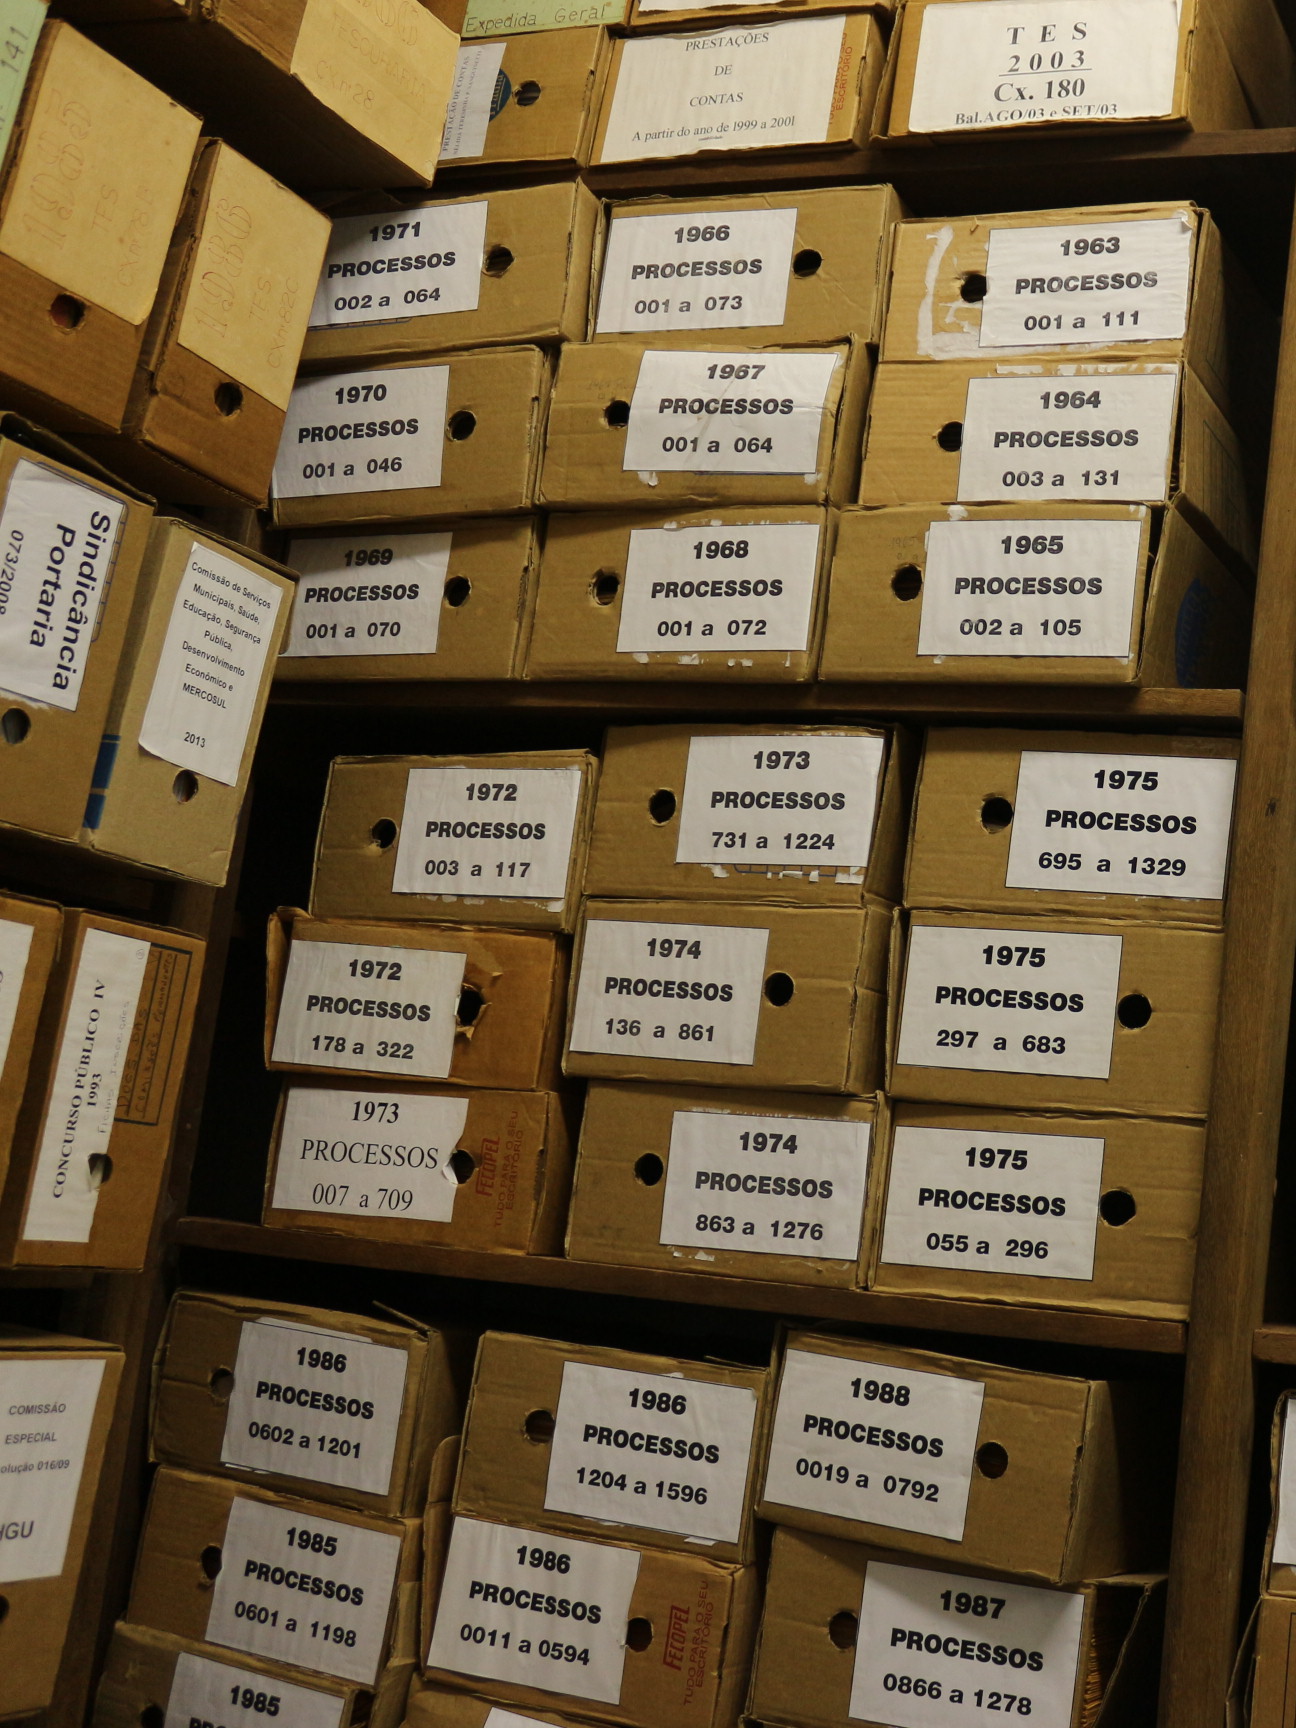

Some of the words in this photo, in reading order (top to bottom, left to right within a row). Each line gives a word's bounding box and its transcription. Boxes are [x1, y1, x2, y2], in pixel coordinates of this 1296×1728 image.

[466, 12, 537, 33] Expedida
[555, 6, 606, 23] Geral
[685, 32, 770, 52] PRESTAÇÕES
[714, 64, 733, 77] DE
[689, 92, 744, 108] CONTAS
[993, 82, 1034, 103] Cx.
[1044, 78, 1086, 99] 180
[954, 107, 1045, 125] Bal.AGO/03
[1050, 108, 1057, 118] e
[1061, 103, 1118, 117] SET/03
[631, 131, 641, 142] A
[644, 128, 675, 143] partir
[677, 126, 691, 137] do
[693, 125, 713, 136] ano
[716, 122, 730, 133] de
[733, 119, 758, 132] 1999
[760, 121, 767, 129] a
[769, 116, 796, 129] 2001
[674, 224, 731, 244] 1966
[631, 258, 763, 280] PROCESSOS
[634, 298, 670, 315] 001
[678, 300, 691, 313] a
[704, 295, 743, 311] 073
[335, 383, 388, 405] 1970
[1040, 390, 1102, 410] 1964
[297, 418, 419, 444] PROCESSOS
[993, 429, 1139, 449] PROCESSOS
[302, 462, 335, 480] 001
[342, 463, 355, 477] a
[366, 456, 403, 474] 046
[1002, 470, 1044, 487] 003
[1051, 473, 1065, 487] a
[1081, 469, 1119, 487] 131
[29, 523, 77, 648] Portaria
[191, 562, 230, 587] Comissão
[232, 582, 241, 596] de
[242, 587, 271, 609] Serviços
[52, 510, 111, 690] Sindicância
[193, 583, 236, 611] Municipais,
[238, 605, 260, 625] Saúde,
[183, 600, 222, 626] Educação,
[225, 620, 261, 644] Segurança
[182, 641, 245, 677] Desenvolvimento
[182, 683, 227, 709] MERCOSUL
[184, 732, 205, 748] 2013
[1093, 769, 1159, 792] 1975
[1044, 809, 1197, 835] PROCESSOS
[1038, 851, 1082, 871] 695
[1096, 858, 1111, 873] a
[1128, 856, 1187, 877] 1329
[646, 937, 702, 960] 1974
[604, 976, 734, 1003] PROCESSOS
[605, 1017, 642, 1037] 136
[652, 1025, 666, 1039] a
[678, 1023, 715, 1042] 861
[53, 1095, 82, 1198] CONCURSO
[74, 1008, 100, 1090] PÚBLICO
[94, 979, 106, 999] IV
[87, 1073, 102, 1107] 1993
[351, 1100, 400, 1124] 1973
[299, 1138, 439, 1170] PROCESSOS
[312, 1182, 350, 1206] 007
[359, 1194, 369, 1208] a
[377, 1187, 414, 1212] 709
[9, 1402, 66, 1415] COMISSÃO
[628, 1387, 687, 1416] 1986
[5, 1432, 57, 1444] ESPECIAL
[582, 1423, 720, 1464] PROCESSOS
[37, 1459, 70, 1470] 016/09
[576, 1466, 628, 1492] 1204
[633, 1480, 647, 1496] a
[655, 1480, 708, 1506] 1596
[698, 1580, 709, 1608] SEU
[940, 1589, 1007, 1620] 1987
[696, 1612, 703, 1622] O
[690, 1628, 701, 1663] PARA
[890, 1627, 1044, 1672] PROCESSOS
[684, 1668, 696, 1706] TUDO
[882, 1672, 943, 1700] 0866
[948, 1688, 964, 1705] a
[973, 1688, 1032, 1716] 1278
